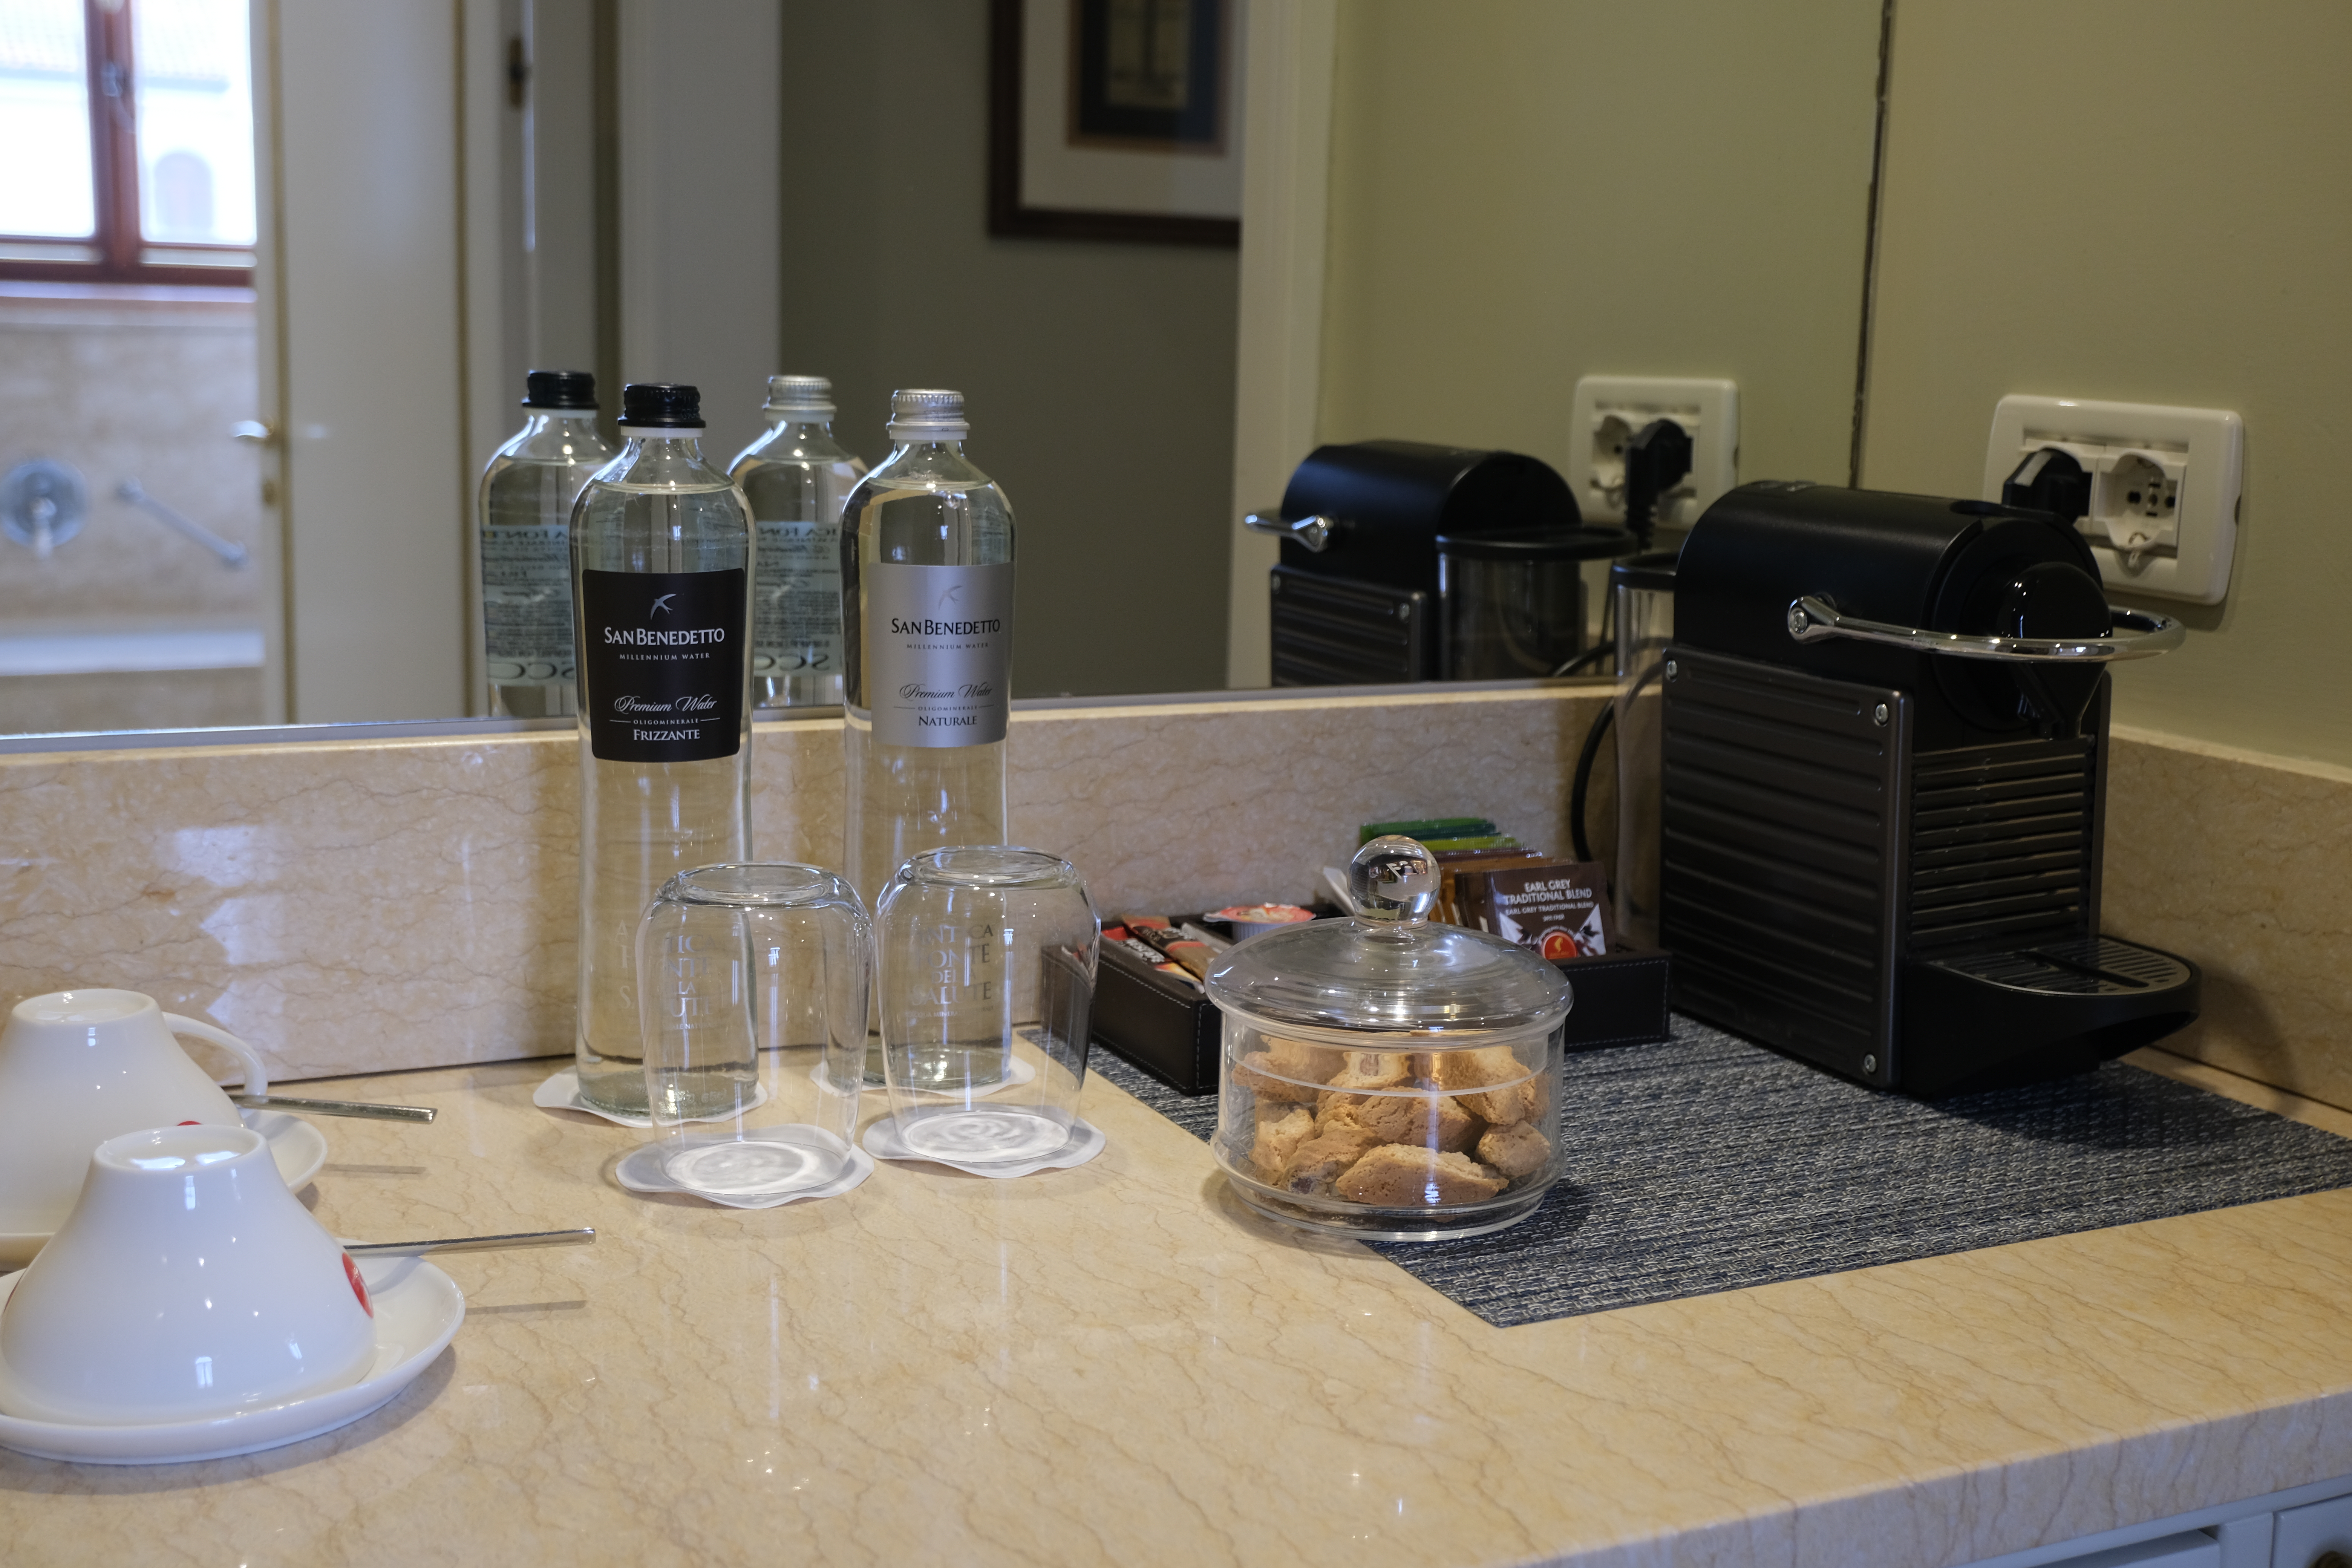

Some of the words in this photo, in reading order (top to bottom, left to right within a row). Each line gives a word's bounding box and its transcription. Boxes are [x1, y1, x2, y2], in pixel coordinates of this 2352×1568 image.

[899, 683, 955, 701] Premium
[958, 681, 992, 698] Water
[614, 695, 672, 715] Premium
[675, 694, 717, 712] Water
[918, 715, 978, 726] NATURALE
[633, 729, 700, 741] FRIZZANTE
[1524, 881, 1547, 892] EARL
[1548, 879, 1571, 890] GREY
[1505, 890, 1565, 905] TRADITIONAL
[1566, 887, 1592, 899] BLEND
[1505, 908, 1521, 916] EARL
[1538, 903, 1576, 912] TRADITIONAL
